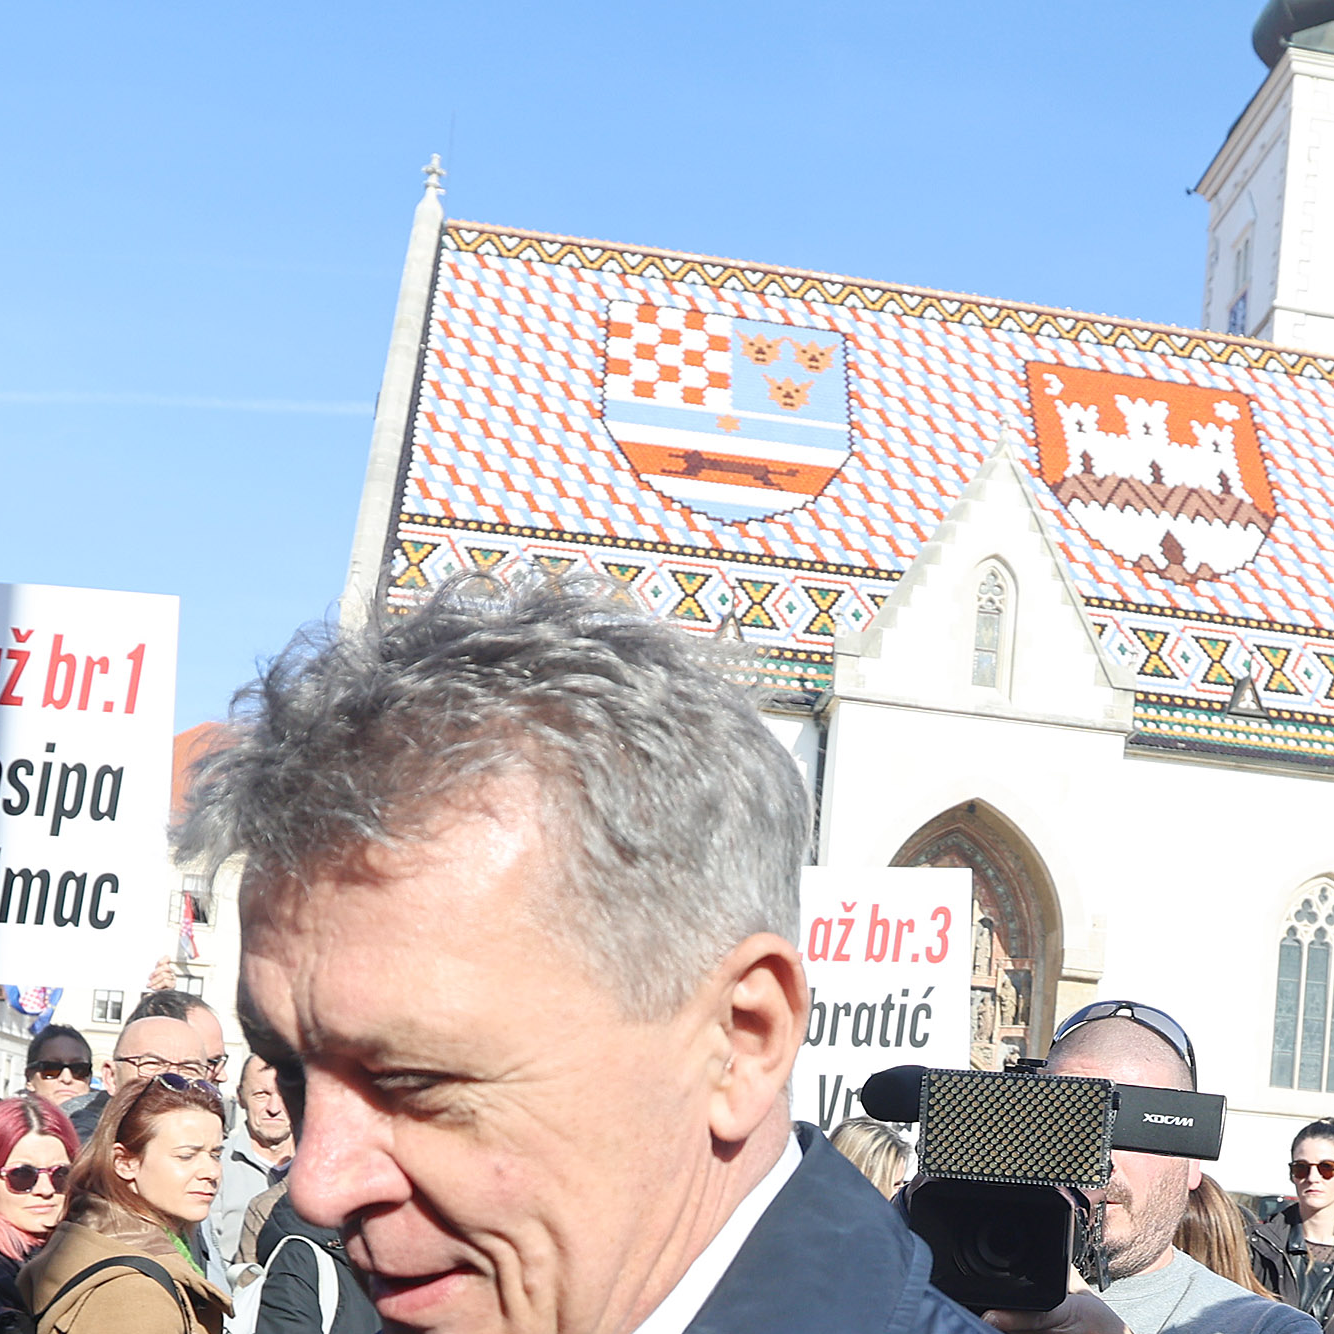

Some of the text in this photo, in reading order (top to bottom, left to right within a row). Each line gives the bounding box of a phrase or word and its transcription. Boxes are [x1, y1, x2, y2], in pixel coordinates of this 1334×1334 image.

[42, 633, 146, 715] br.1
[799, 901, 952, 964] až br.3
[801, 986, 935, 1049] bratić
[1142, 1112, 1194, 1127] XDCAM
